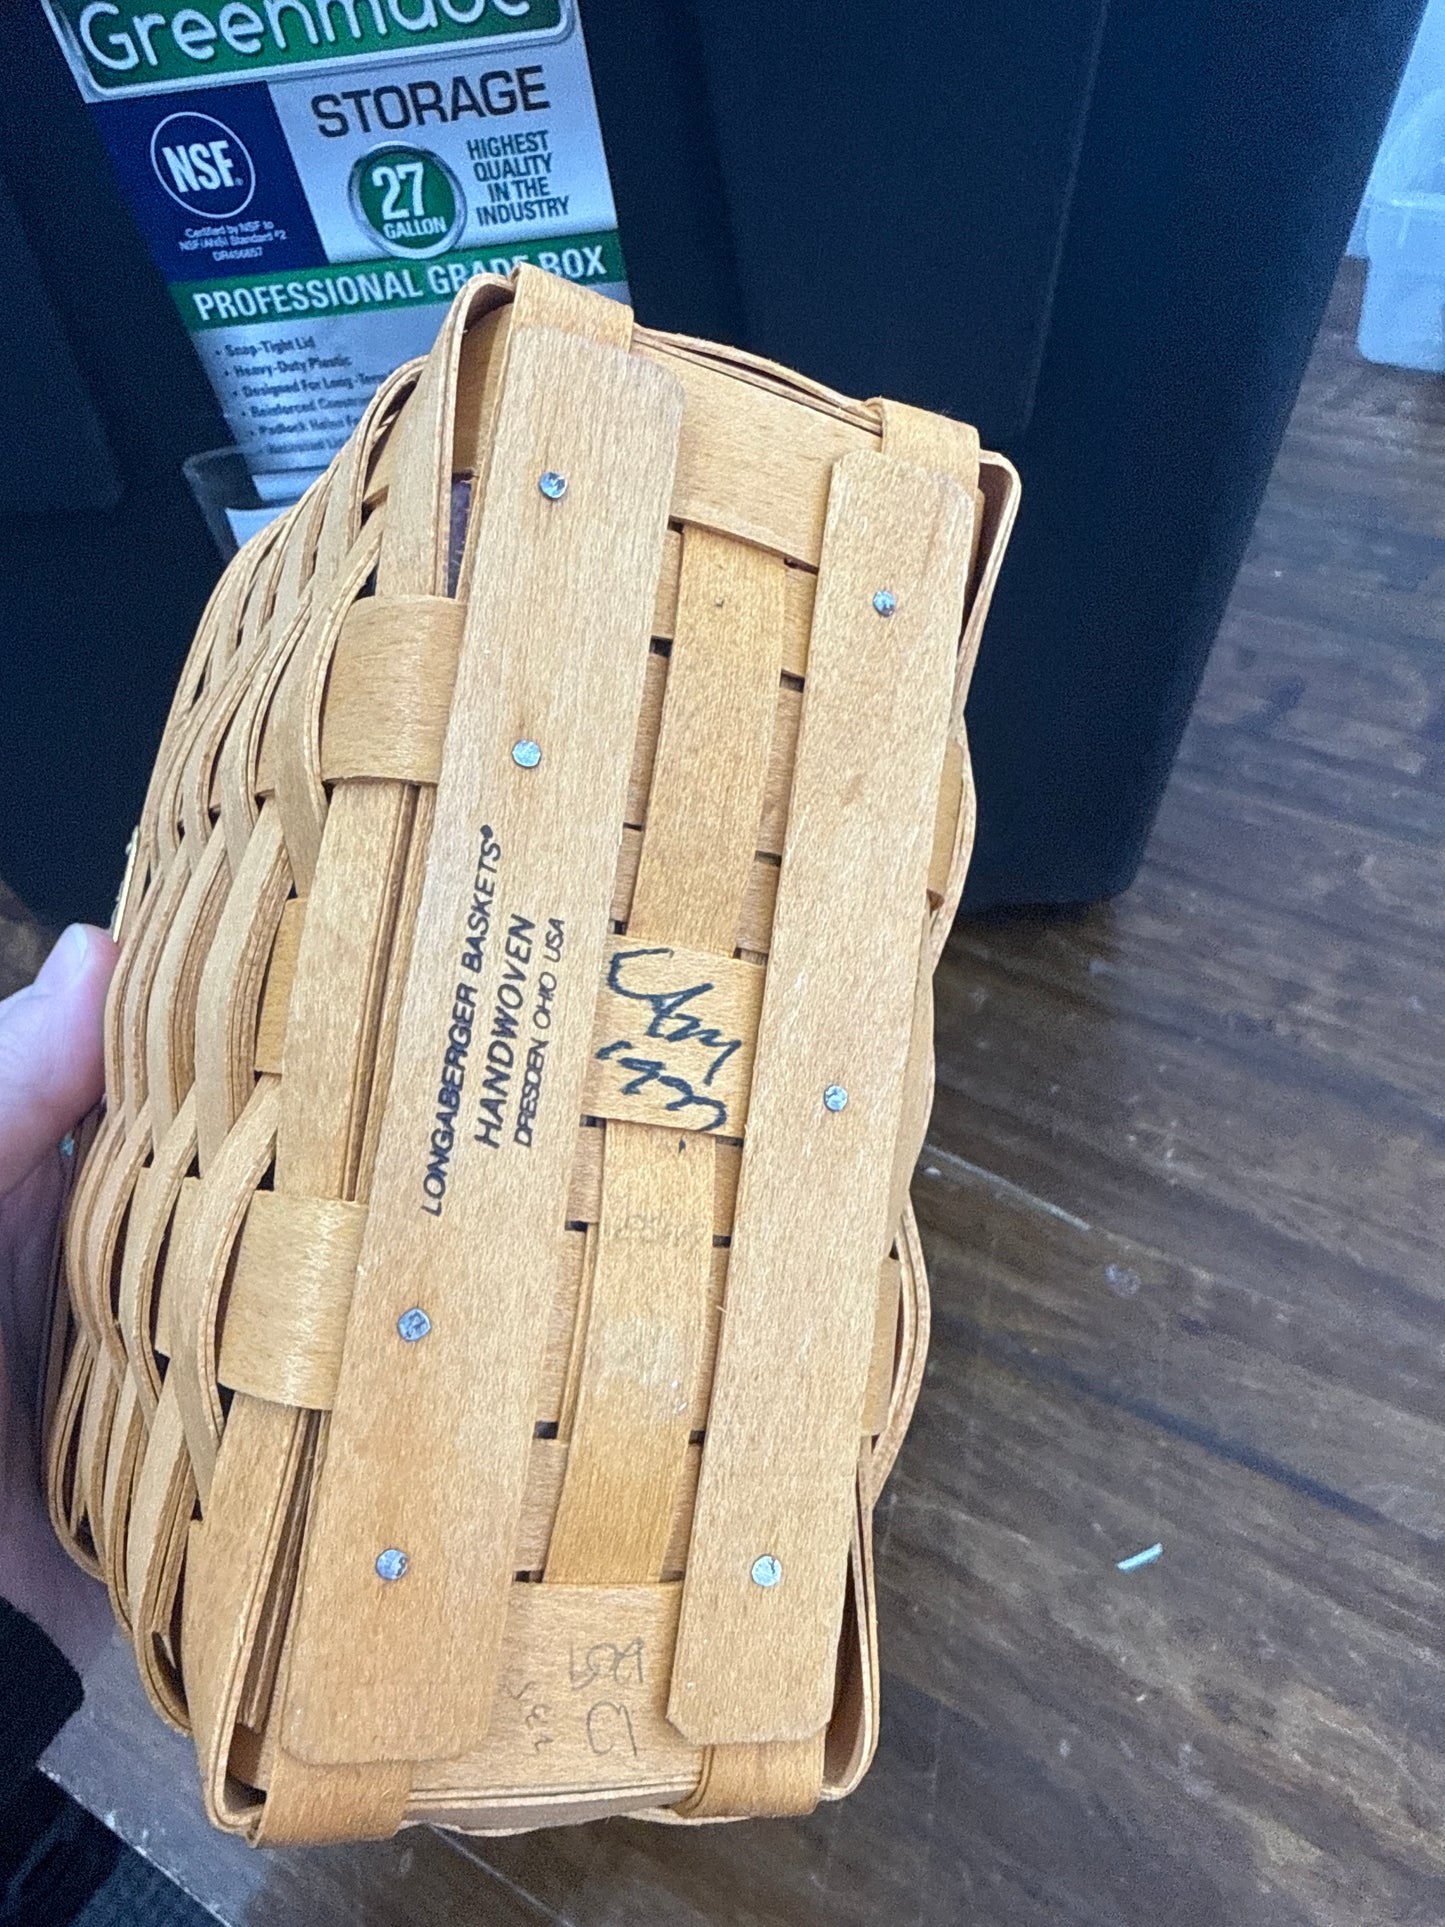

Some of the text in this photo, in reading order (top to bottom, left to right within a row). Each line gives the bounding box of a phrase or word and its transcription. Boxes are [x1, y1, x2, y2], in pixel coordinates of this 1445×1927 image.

[311, 65, 551, 139] STORAGE
[466, 129, 550, 161] HIGHEST
[473, 152, 552, 183] QUALITY
[371, 161, 426, 221] 27
[475, 195, 570, 227] INDUSTRY
[487, 176, 551, 204] IN THE
[262, 220, 275, 230] to
[383, 216, 447, 240] GALLON
[192, 269, 424, 322] PROFESSIONAL
[538, 245, 608, 279] BOX
[474, 913, 536, 1150] HANDWOVEN
[513, 917, 565, 1149] DRESDEN OHIO USA
[420, 982, 478, 1218] LONGABERGER
